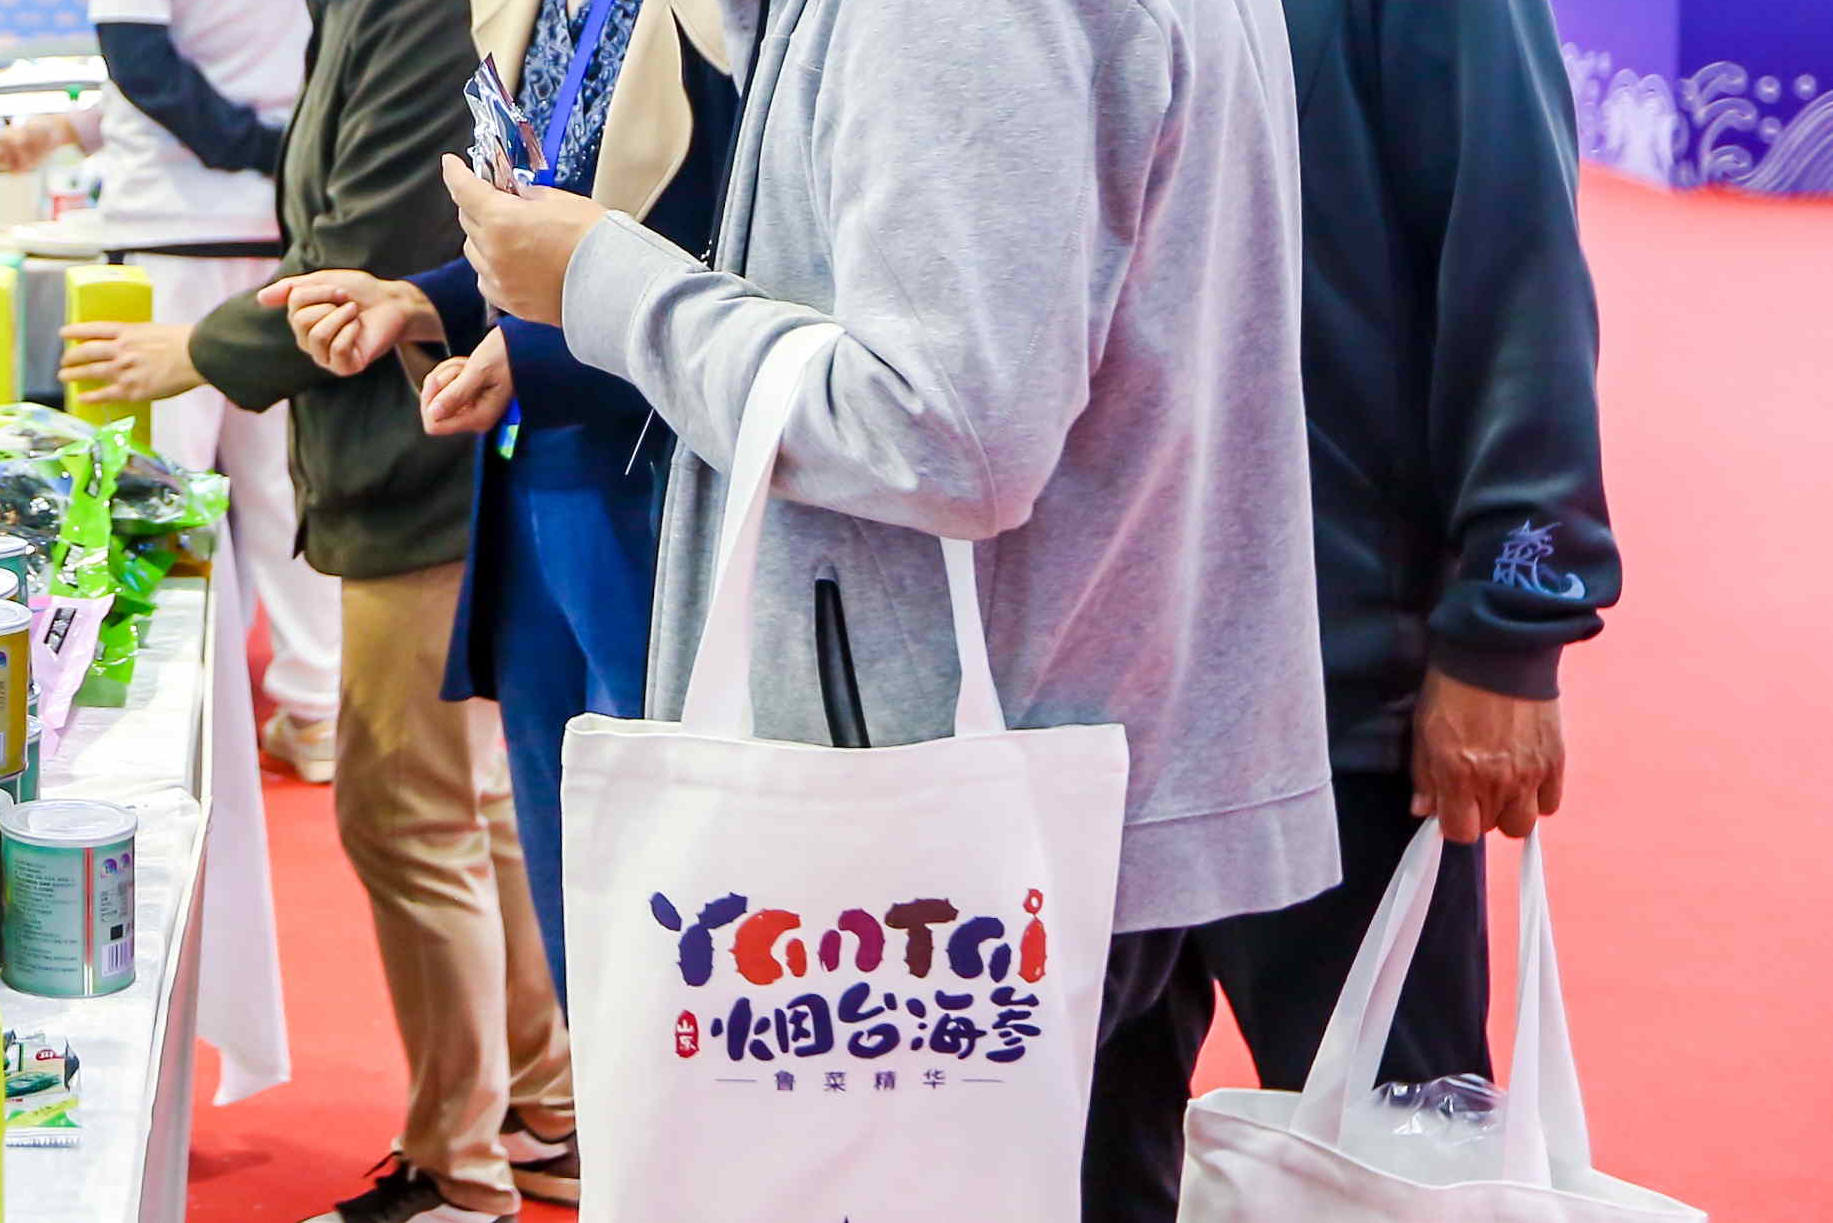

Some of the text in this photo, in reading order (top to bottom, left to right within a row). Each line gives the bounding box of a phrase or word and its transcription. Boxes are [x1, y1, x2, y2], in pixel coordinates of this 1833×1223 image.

[711, 982, 1042, 1063] 烟台海参
[774, 1069, 946, 1092] 鲁菜精华
